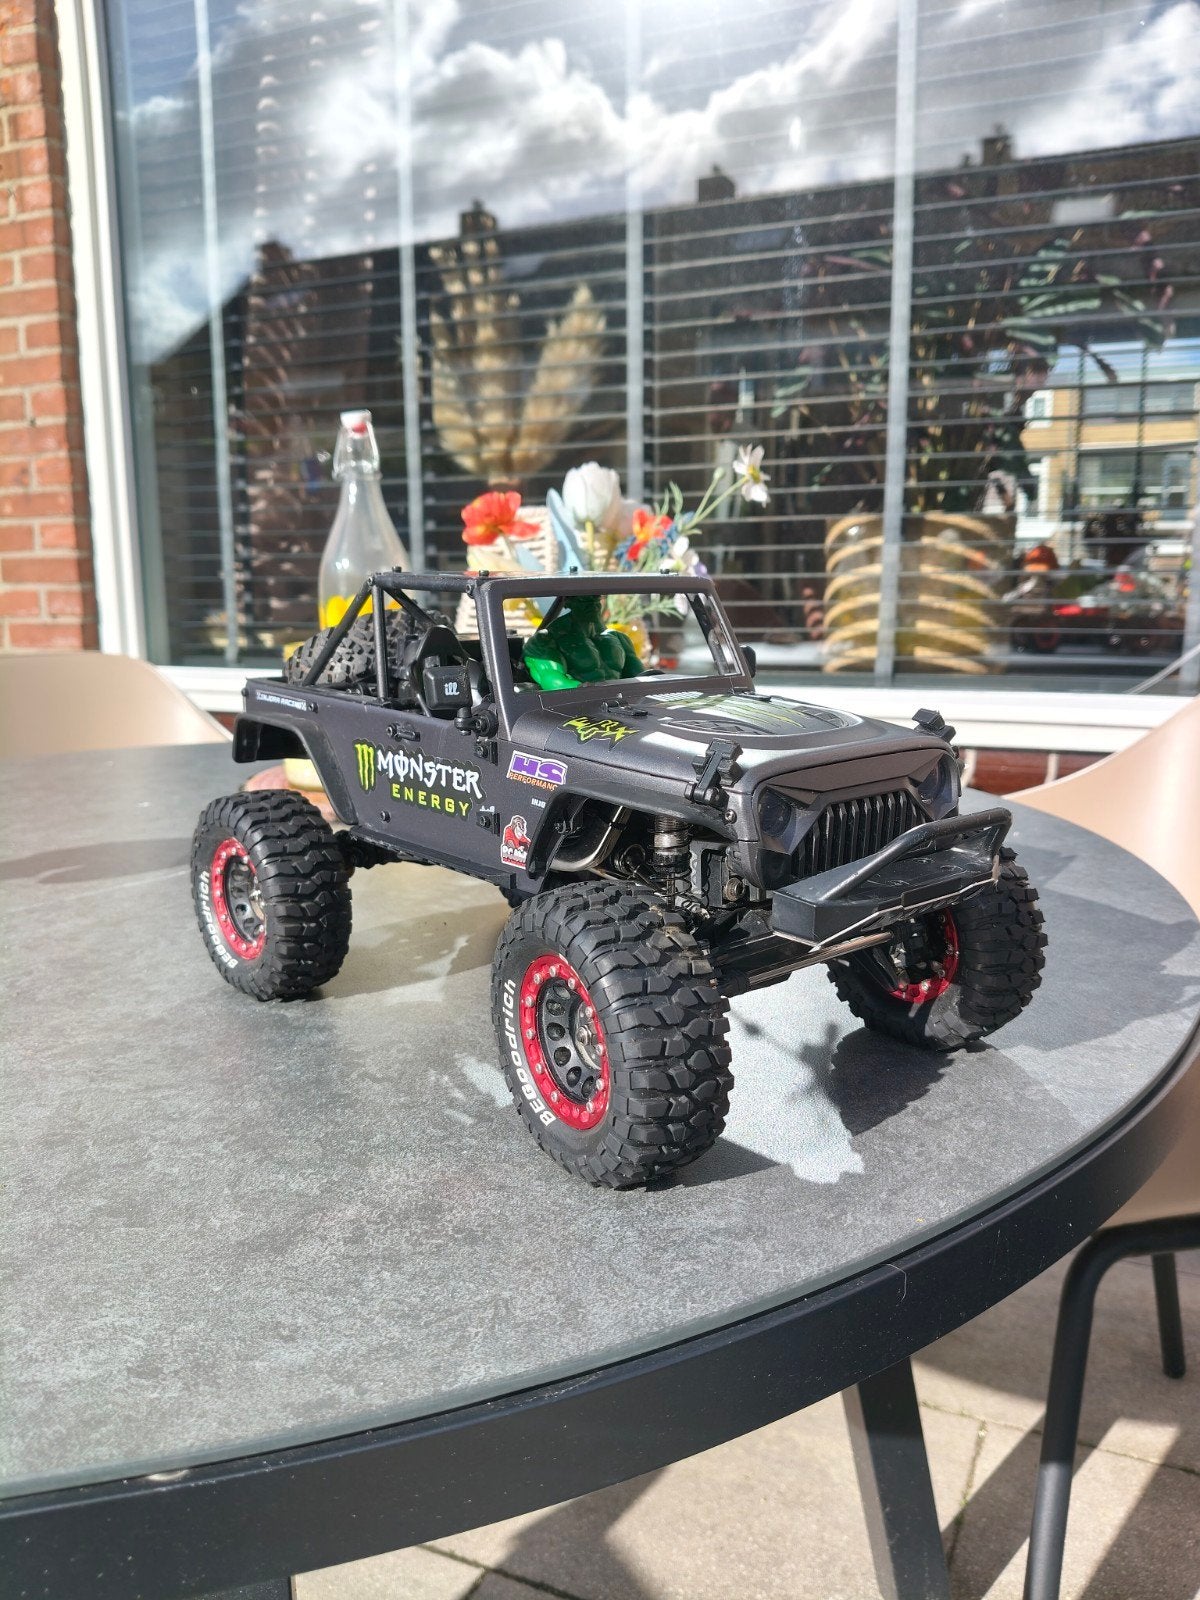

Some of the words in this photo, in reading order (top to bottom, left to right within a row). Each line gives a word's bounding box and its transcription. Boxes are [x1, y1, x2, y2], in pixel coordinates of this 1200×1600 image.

[376, 749, 483, 799] MONSTER
[512, 755, 564, 784] HS
[391, 783, 470, 816] ENERGY
